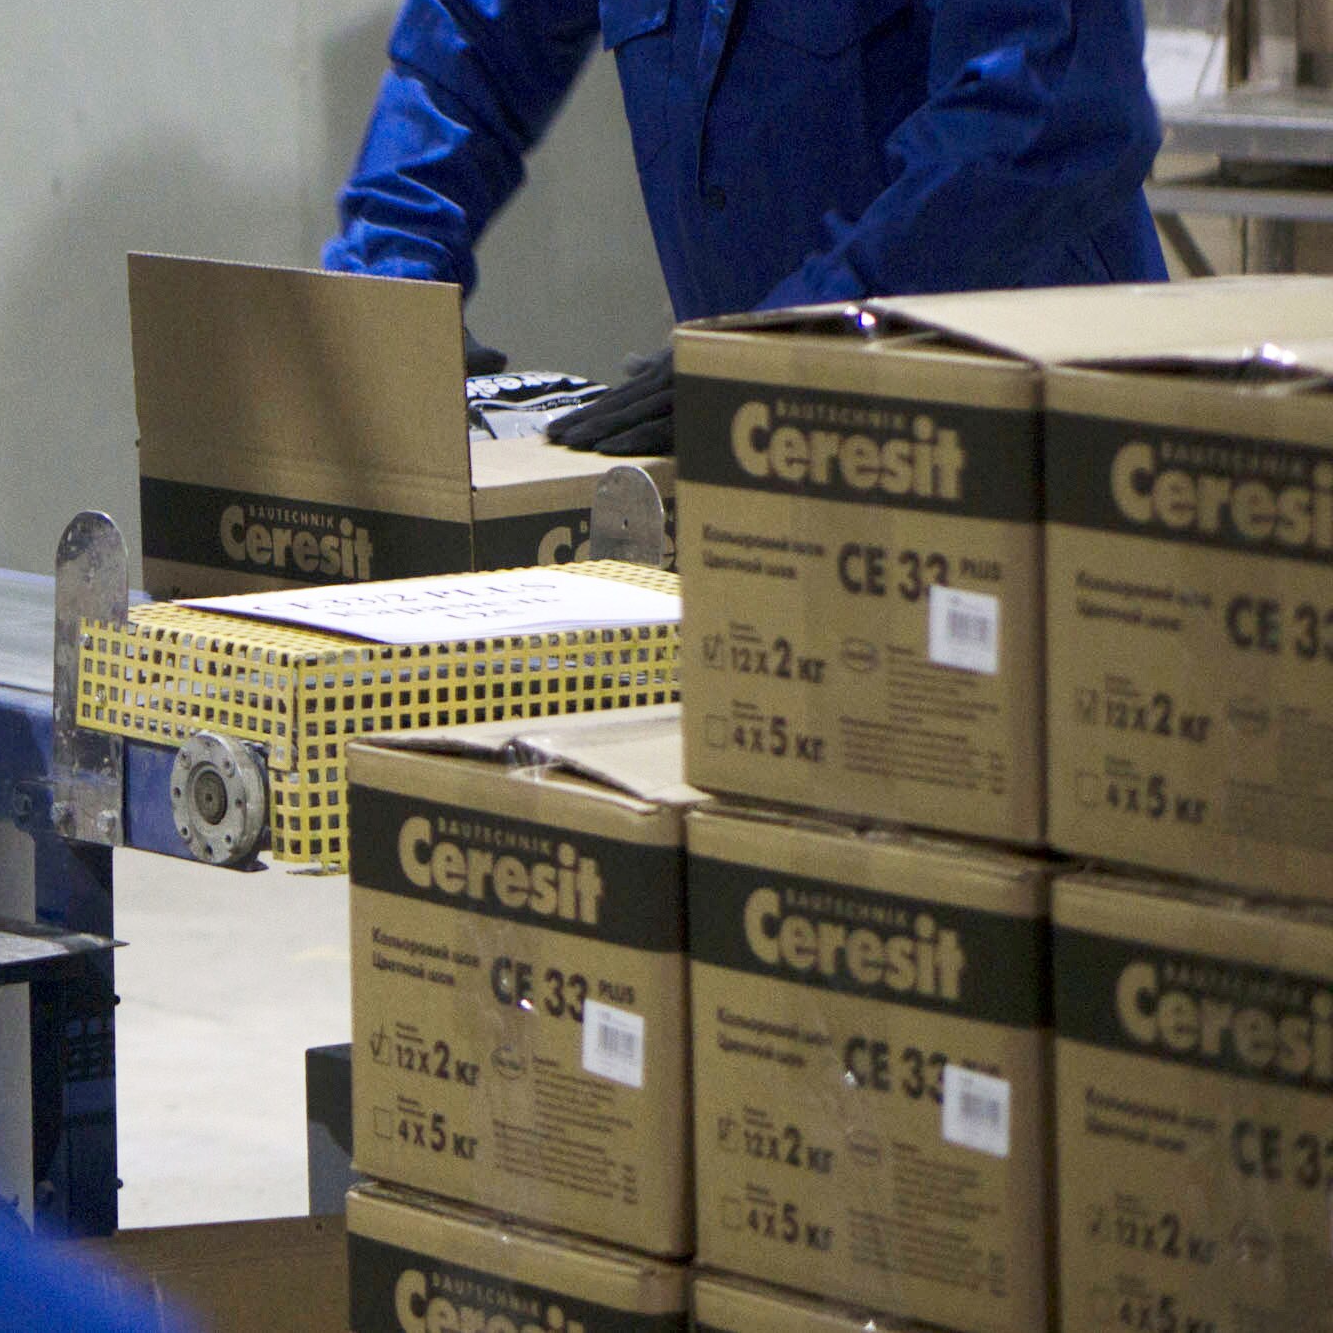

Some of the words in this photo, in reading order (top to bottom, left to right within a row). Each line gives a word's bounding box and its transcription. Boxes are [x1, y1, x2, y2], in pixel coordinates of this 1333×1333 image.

[730, 400, 967, 501] Ceresit
[1111, 441, 1333, 548] Ceresi
[220, 504, 374, 581] Ceresit
[838, 541, 888, 597] CE
[1225, 593, 1281, 653] CE
[1293, 601, 1333, 660] 3
[397, 816, 604, 924] Ceresit
[744, 887, 967, 1001] Ceresit
[544, 968, 587, 1023] 33
[1117, 960, 1333, 1080] Ceresi
[843, 1036, 891, 1091] CE
